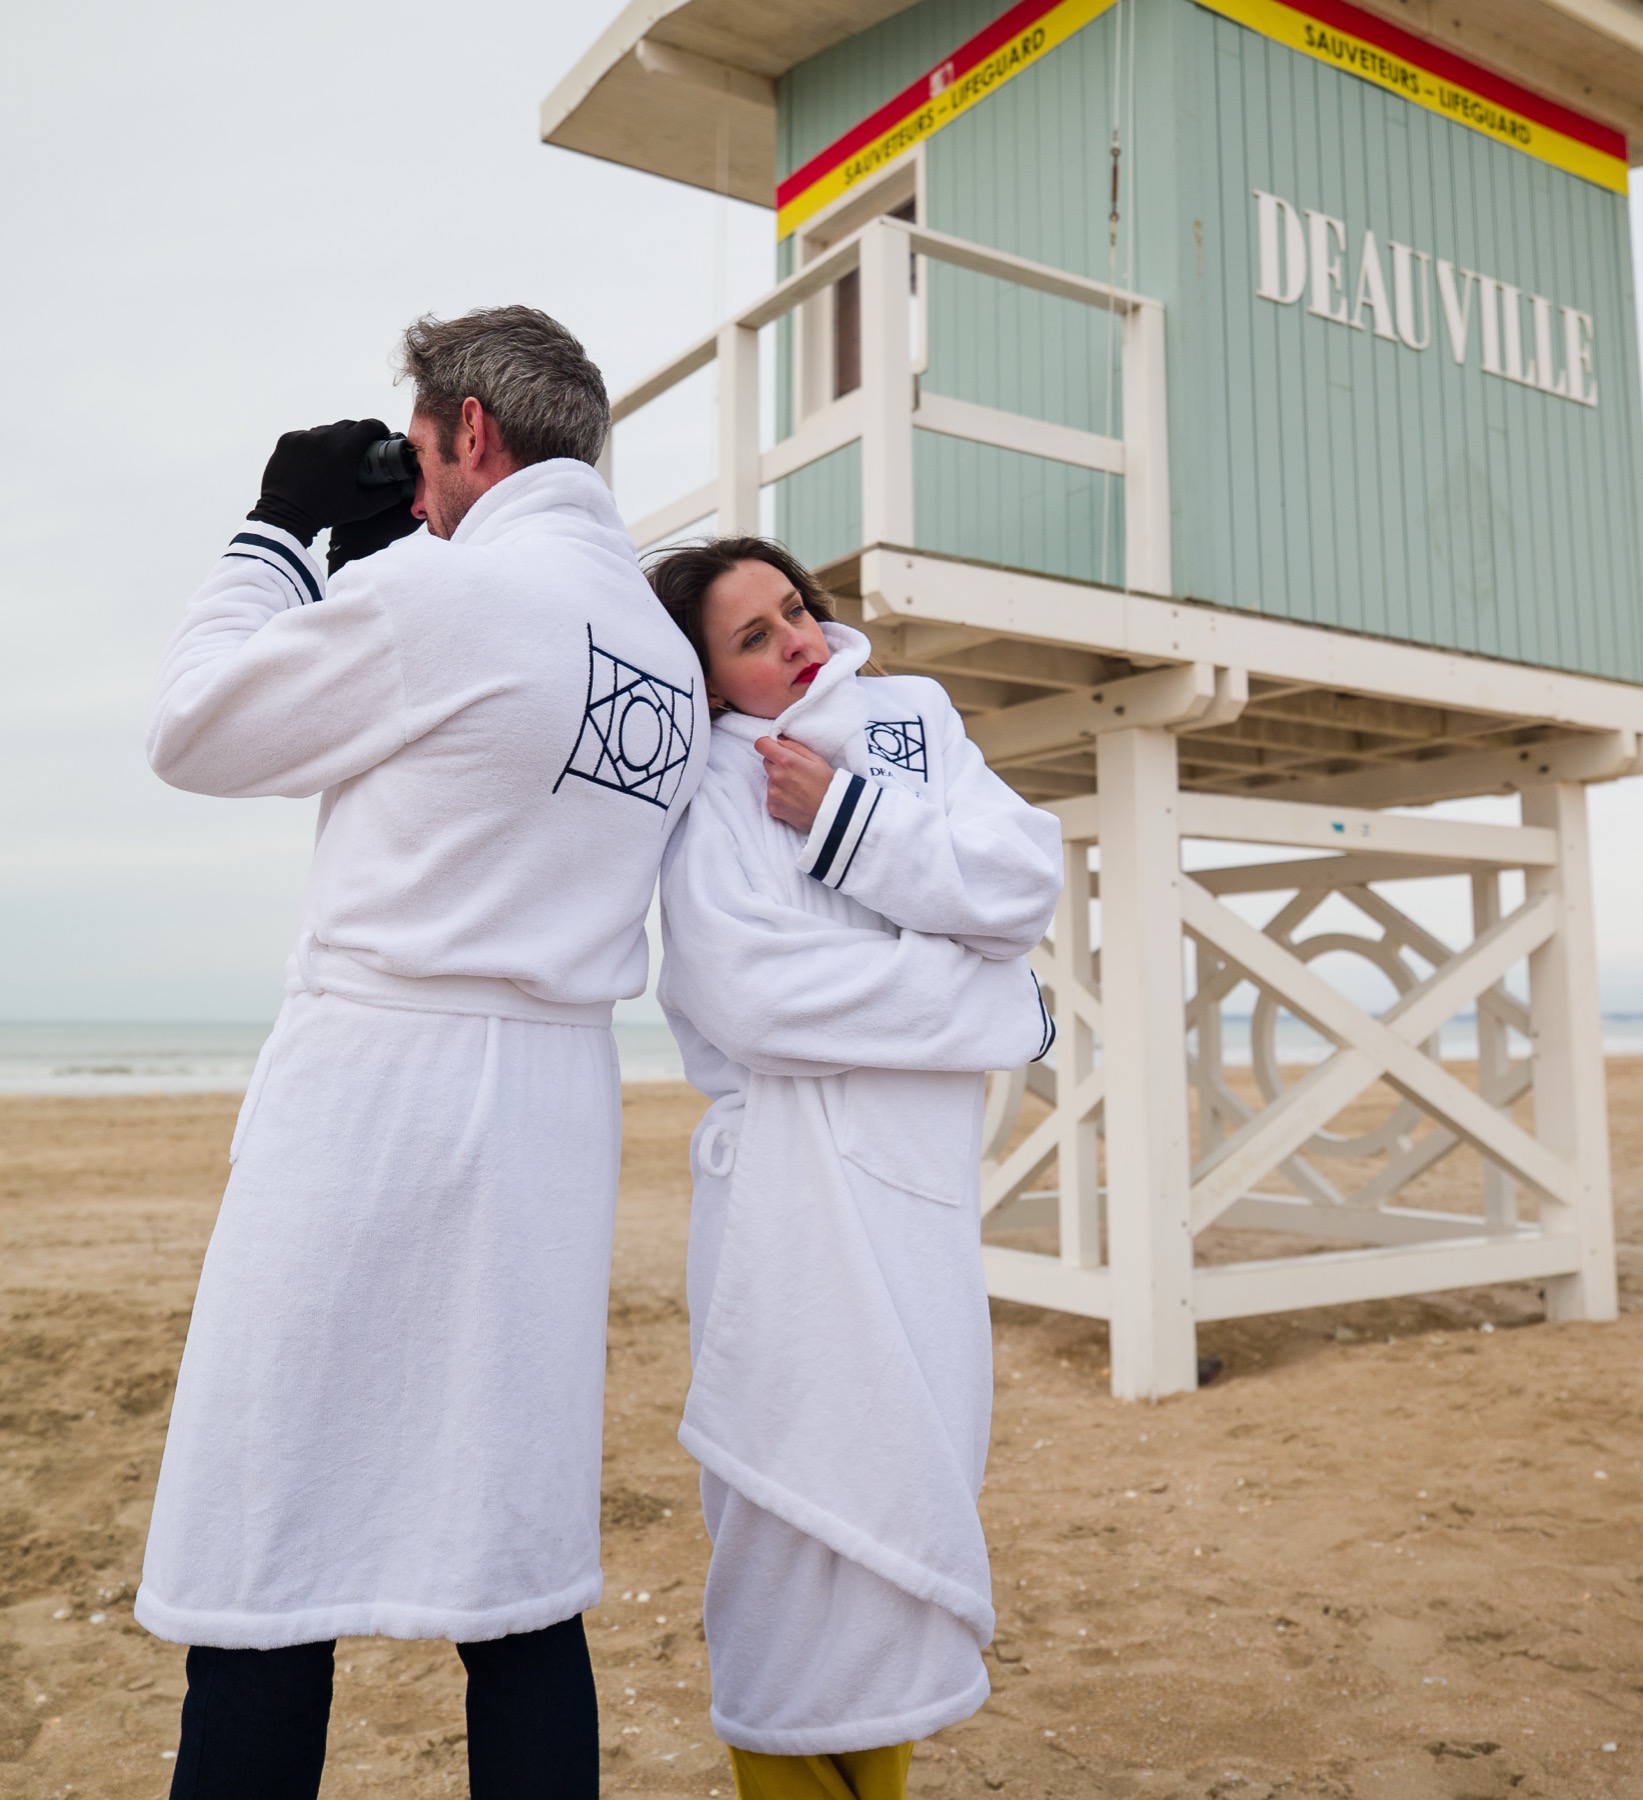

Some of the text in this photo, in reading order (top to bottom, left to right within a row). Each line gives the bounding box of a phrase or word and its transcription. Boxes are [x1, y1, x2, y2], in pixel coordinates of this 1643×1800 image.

[845, 106, 934, 185] SAUVETEURS
[951, 27, 1045, 109] LIFEGUARD
[1304, 24, 1420, 95] SAUVETEURS
[1439, 87, 1531, 145] LIFEGUARD
[1253, 188, 1598, 408] DEAUVILLE
